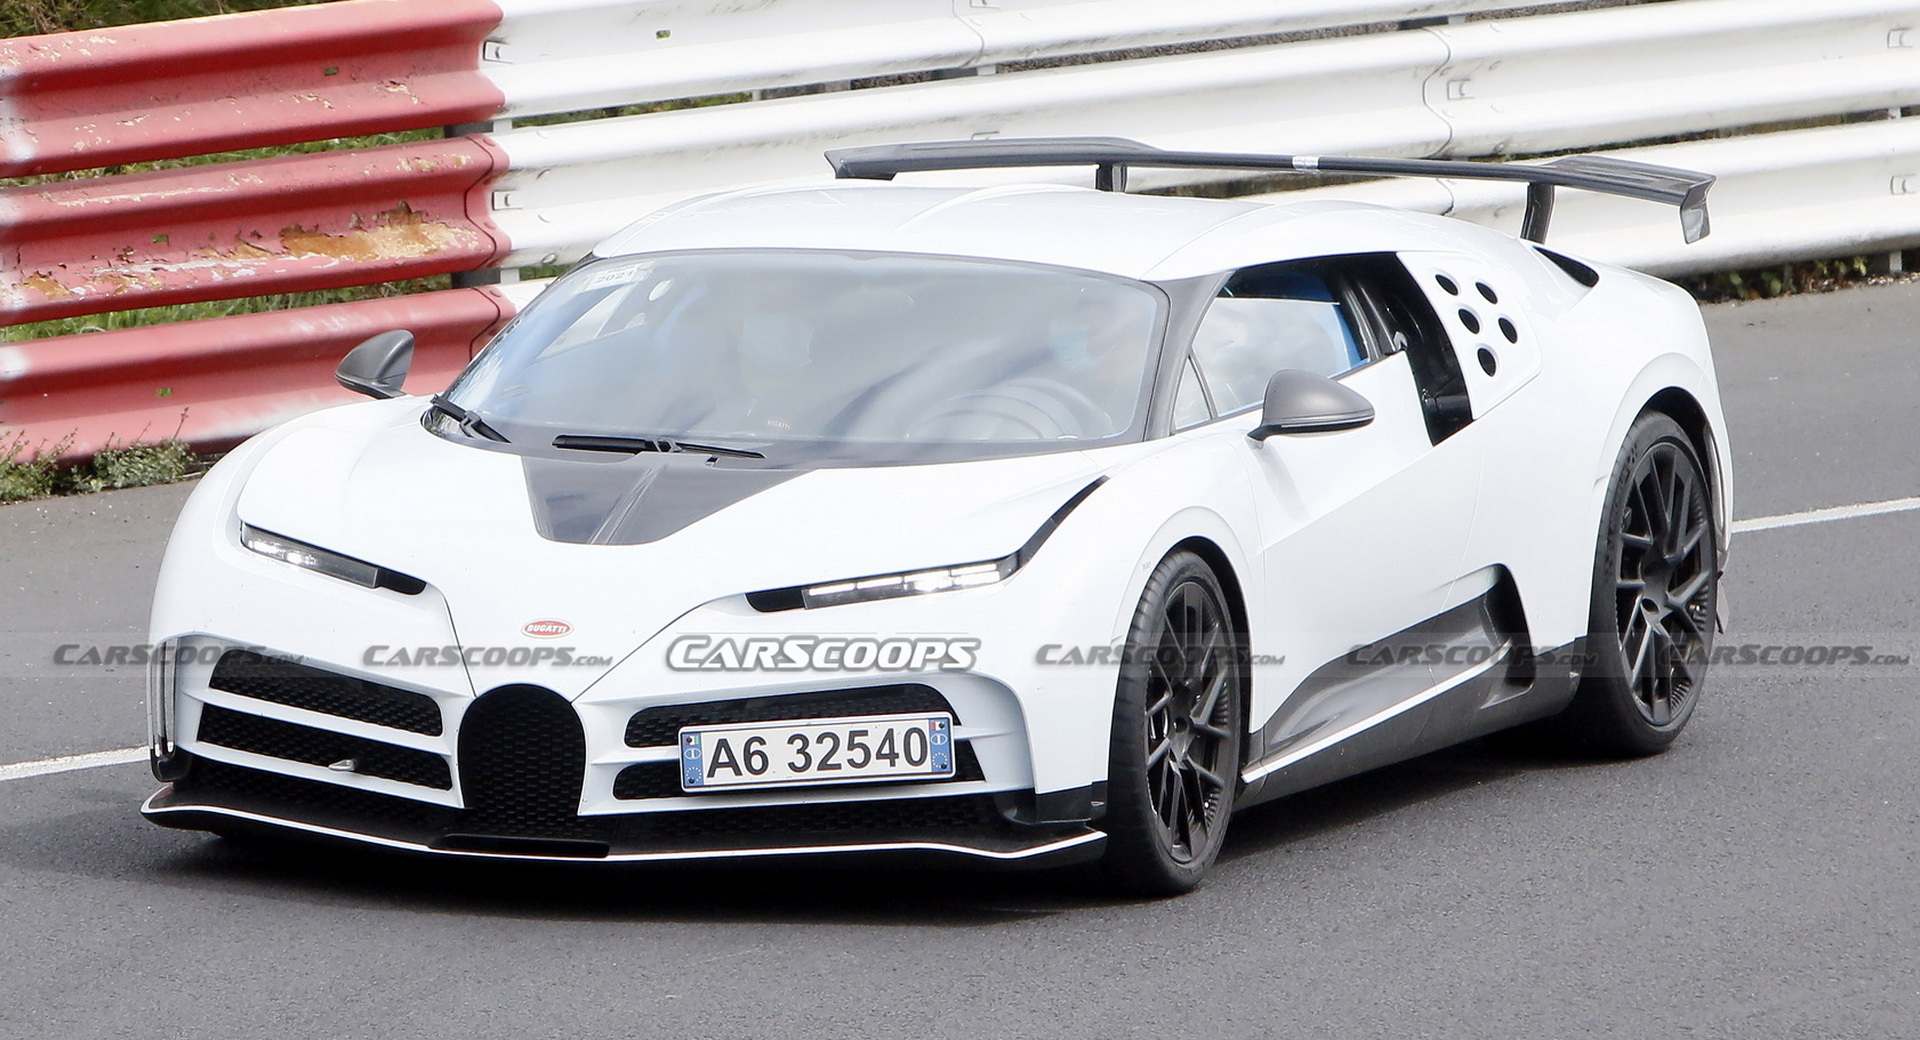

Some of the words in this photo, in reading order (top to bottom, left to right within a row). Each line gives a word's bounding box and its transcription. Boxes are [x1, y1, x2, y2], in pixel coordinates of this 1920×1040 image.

[526, 624, 568, 634] BUGATTI
[706, 735, 770, 779] A6
[786, 726, 929, 774] 32540
